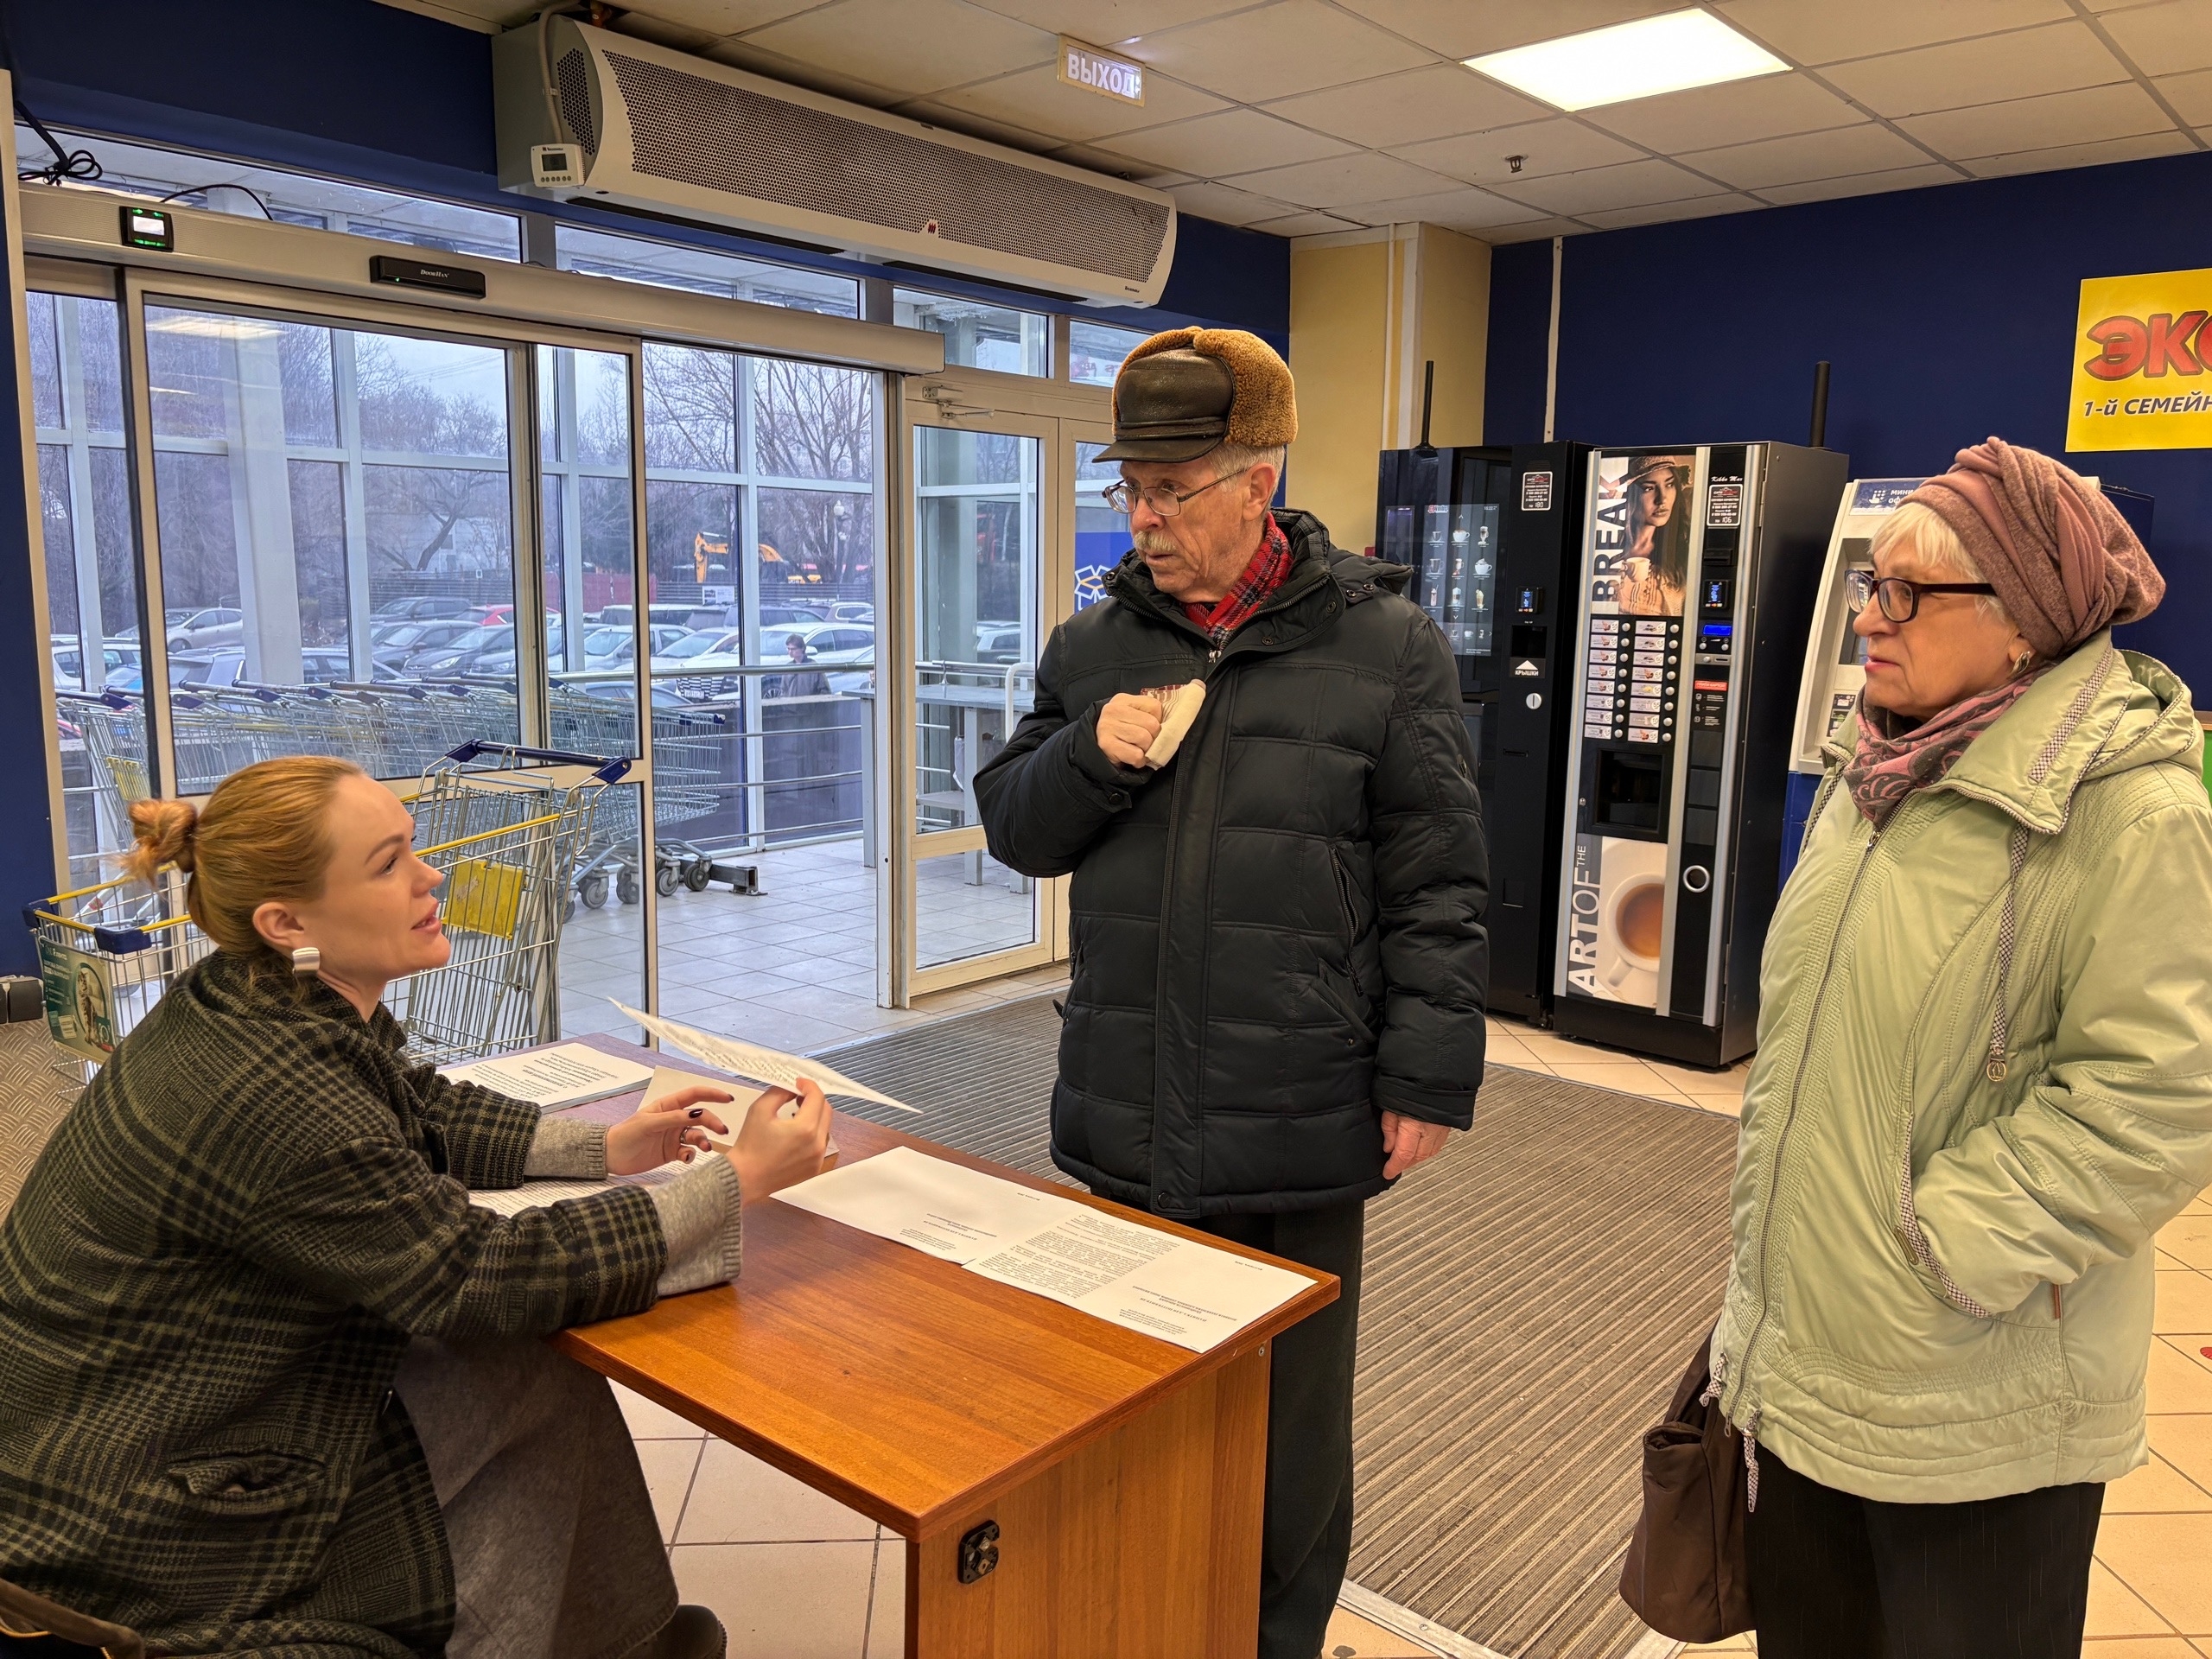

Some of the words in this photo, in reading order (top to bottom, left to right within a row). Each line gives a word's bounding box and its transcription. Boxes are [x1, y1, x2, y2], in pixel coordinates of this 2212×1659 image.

[1068, 54, 1136, 99] ВЫХОД
[2083, 310, 2212, 381] ЭК
[2084, 398, 2118, 416] 1-й
[1592, 473, 1630, 601] BREAK
[1577, 845, 1586, 867] THE
[1573, 867, 1601, 915] OF
[1568, 913, 1598, 997] ART
